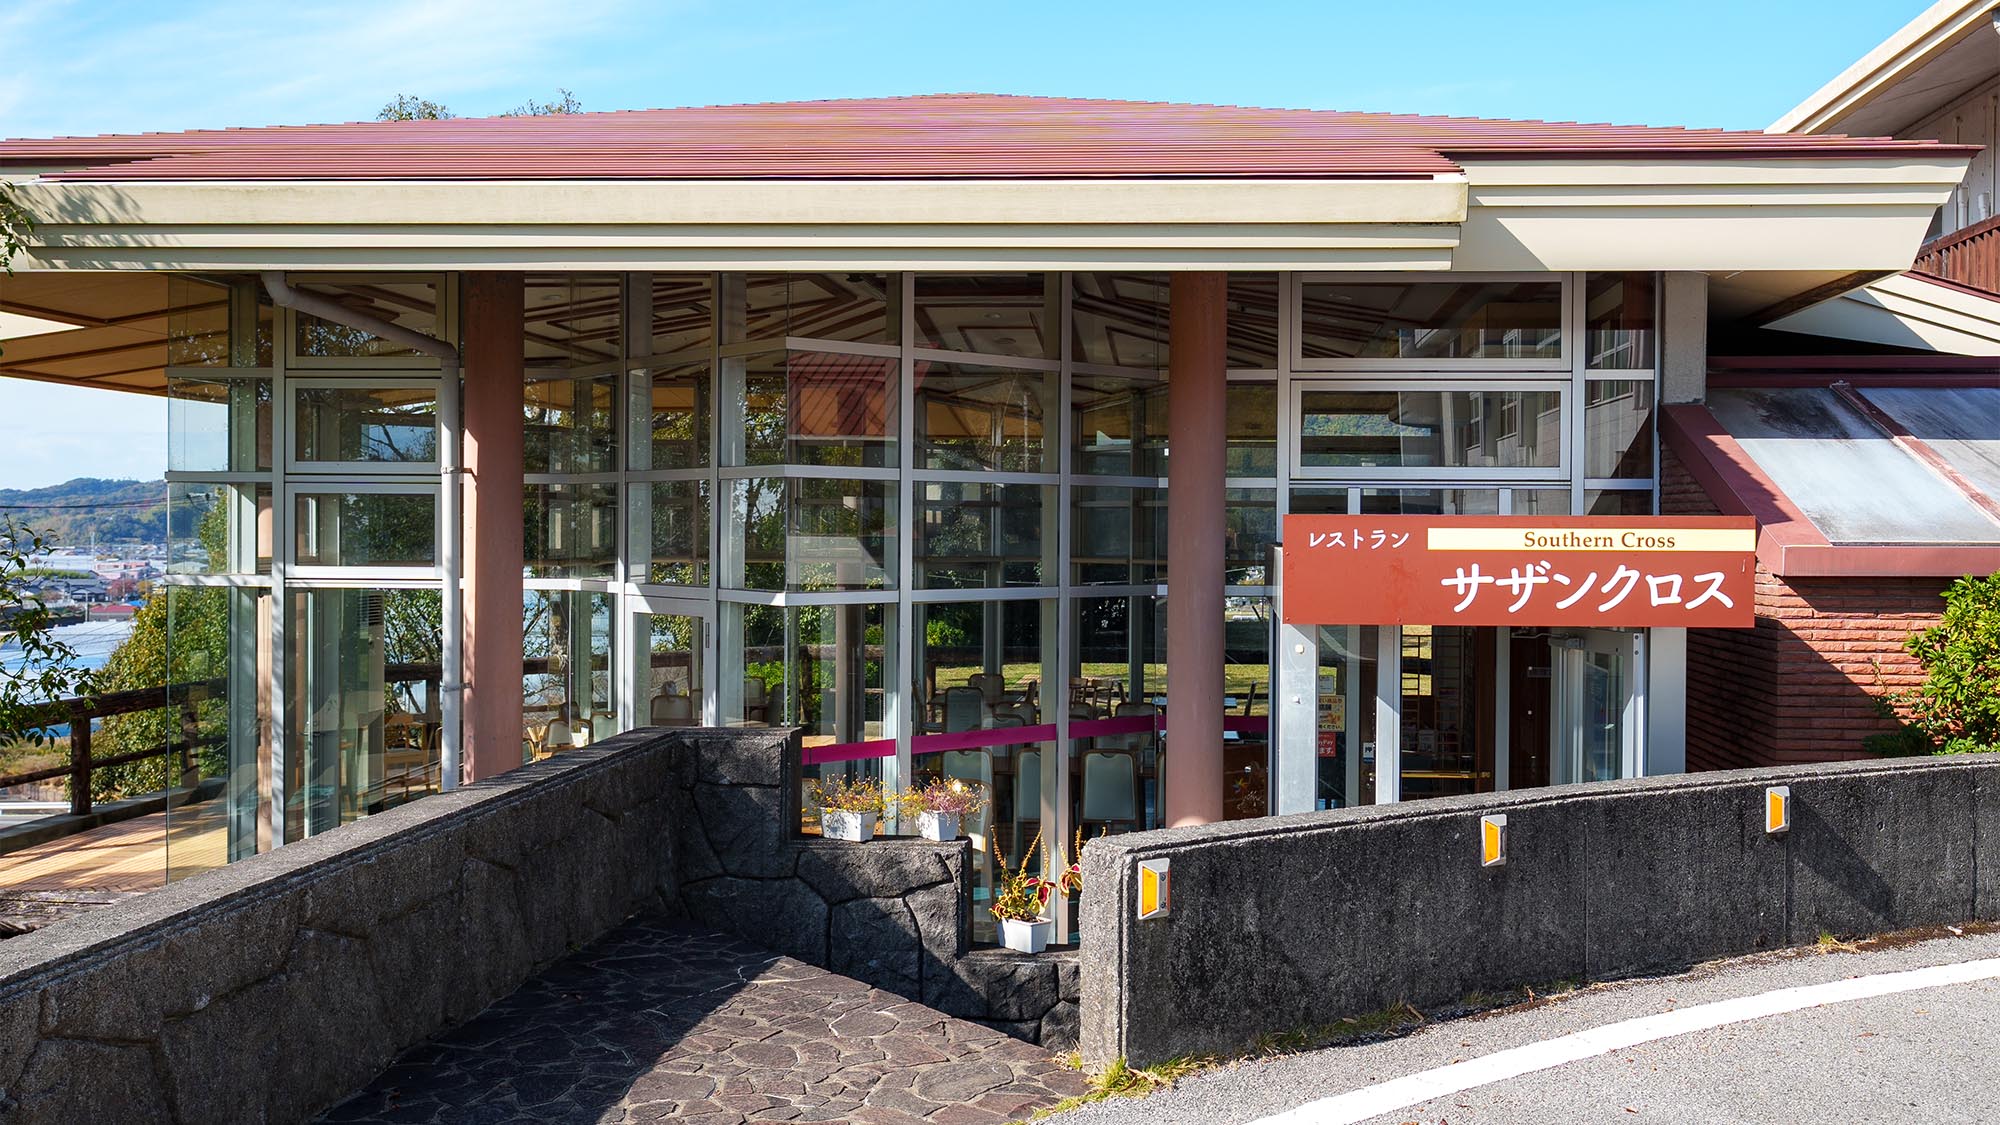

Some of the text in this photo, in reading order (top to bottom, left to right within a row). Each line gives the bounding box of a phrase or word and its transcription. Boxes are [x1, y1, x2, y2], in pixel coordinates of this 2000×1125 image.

[1308, 528, 1410, 550] レストラン
[1524, 531, 1676, 548] Southern Cross
[1440, 559, 1734, 613] サザンクロス
